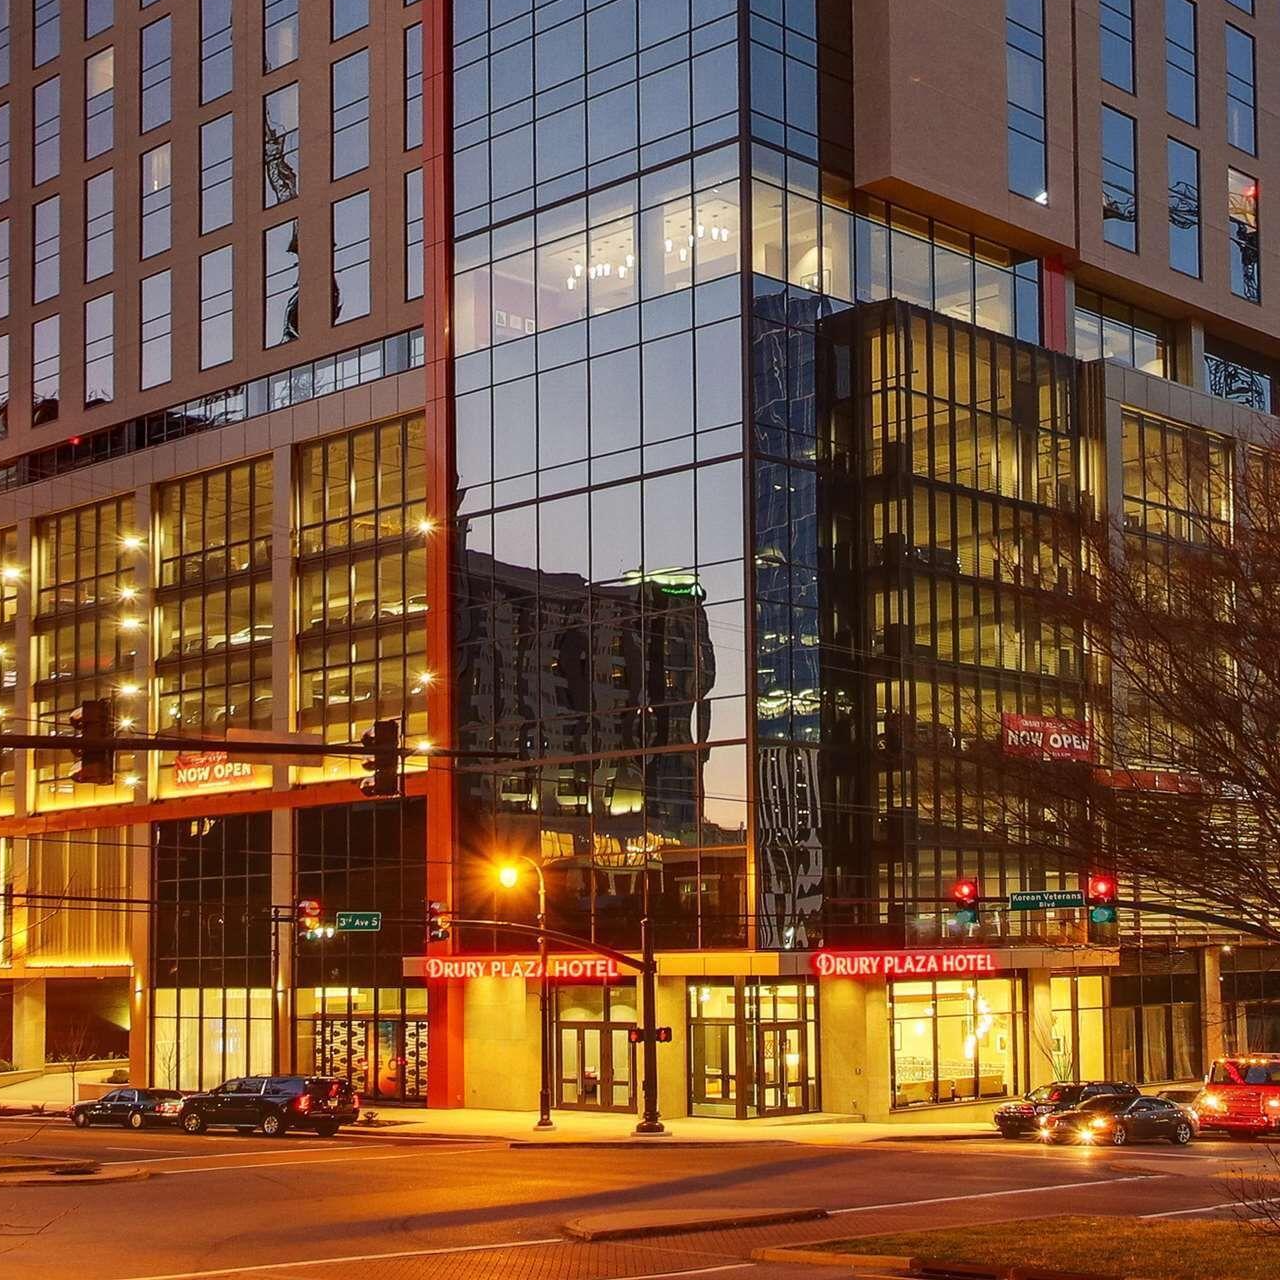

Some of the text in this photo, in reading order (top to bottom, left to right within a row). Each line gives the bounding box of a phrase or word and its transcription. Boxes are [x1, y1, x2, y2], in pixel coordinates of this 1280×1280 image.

[1007, 729, 1090, 751] NOW OPEN
[177, 762, 252, 783] NOW OPEN
[372, 918, 377, 926] S
[426, 959, 486, 978] DRURY
[556, 960, 618, 977] HOTEL
[817, 953, 995, 975] DRURY PLAZA HOTEL
